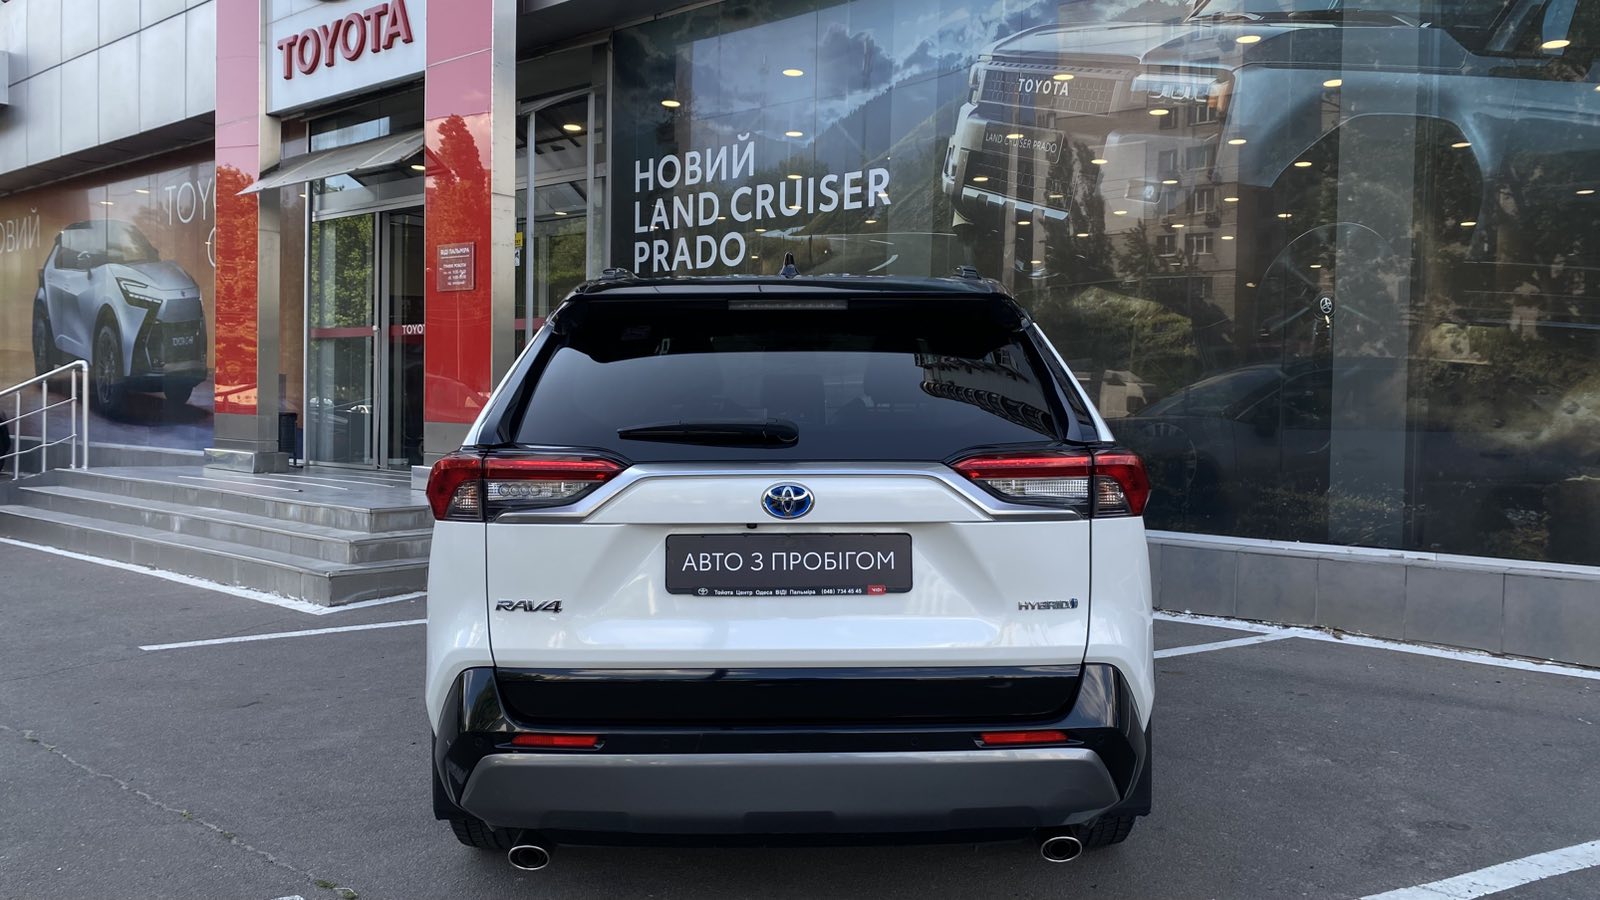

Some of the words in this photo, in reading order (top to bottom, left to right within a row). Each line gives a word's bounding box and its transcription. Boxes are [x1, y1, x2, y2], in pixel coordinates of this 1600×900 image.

[277, 0, 414, 80] TOYOTA
[1018, 78, 1069, 96] TOYOTA
[985, 132, 1003, 144] LAND
[1033, 140, 1058, 154] PRADO
[634, 132, 755, 192] НОВИЙ
[164, 177, 216, 226] TOY
[634, 191, 719, 234] LAND
[730, 167, 892, 222] CRUISER
[634, 231, 746, 274] PRADO
[682, 552, 743, 572] АВТО
[771, 551, 895, 571] ПРОБІГОМ
[735, 589, 753, 597] Центр
[789, 588, 817, 596] Пальміра
[821, 587, 836, 595] (048)
[495, 599, 563, 613] RAV4
[1017, 600, 1070, 611] HYBRID
